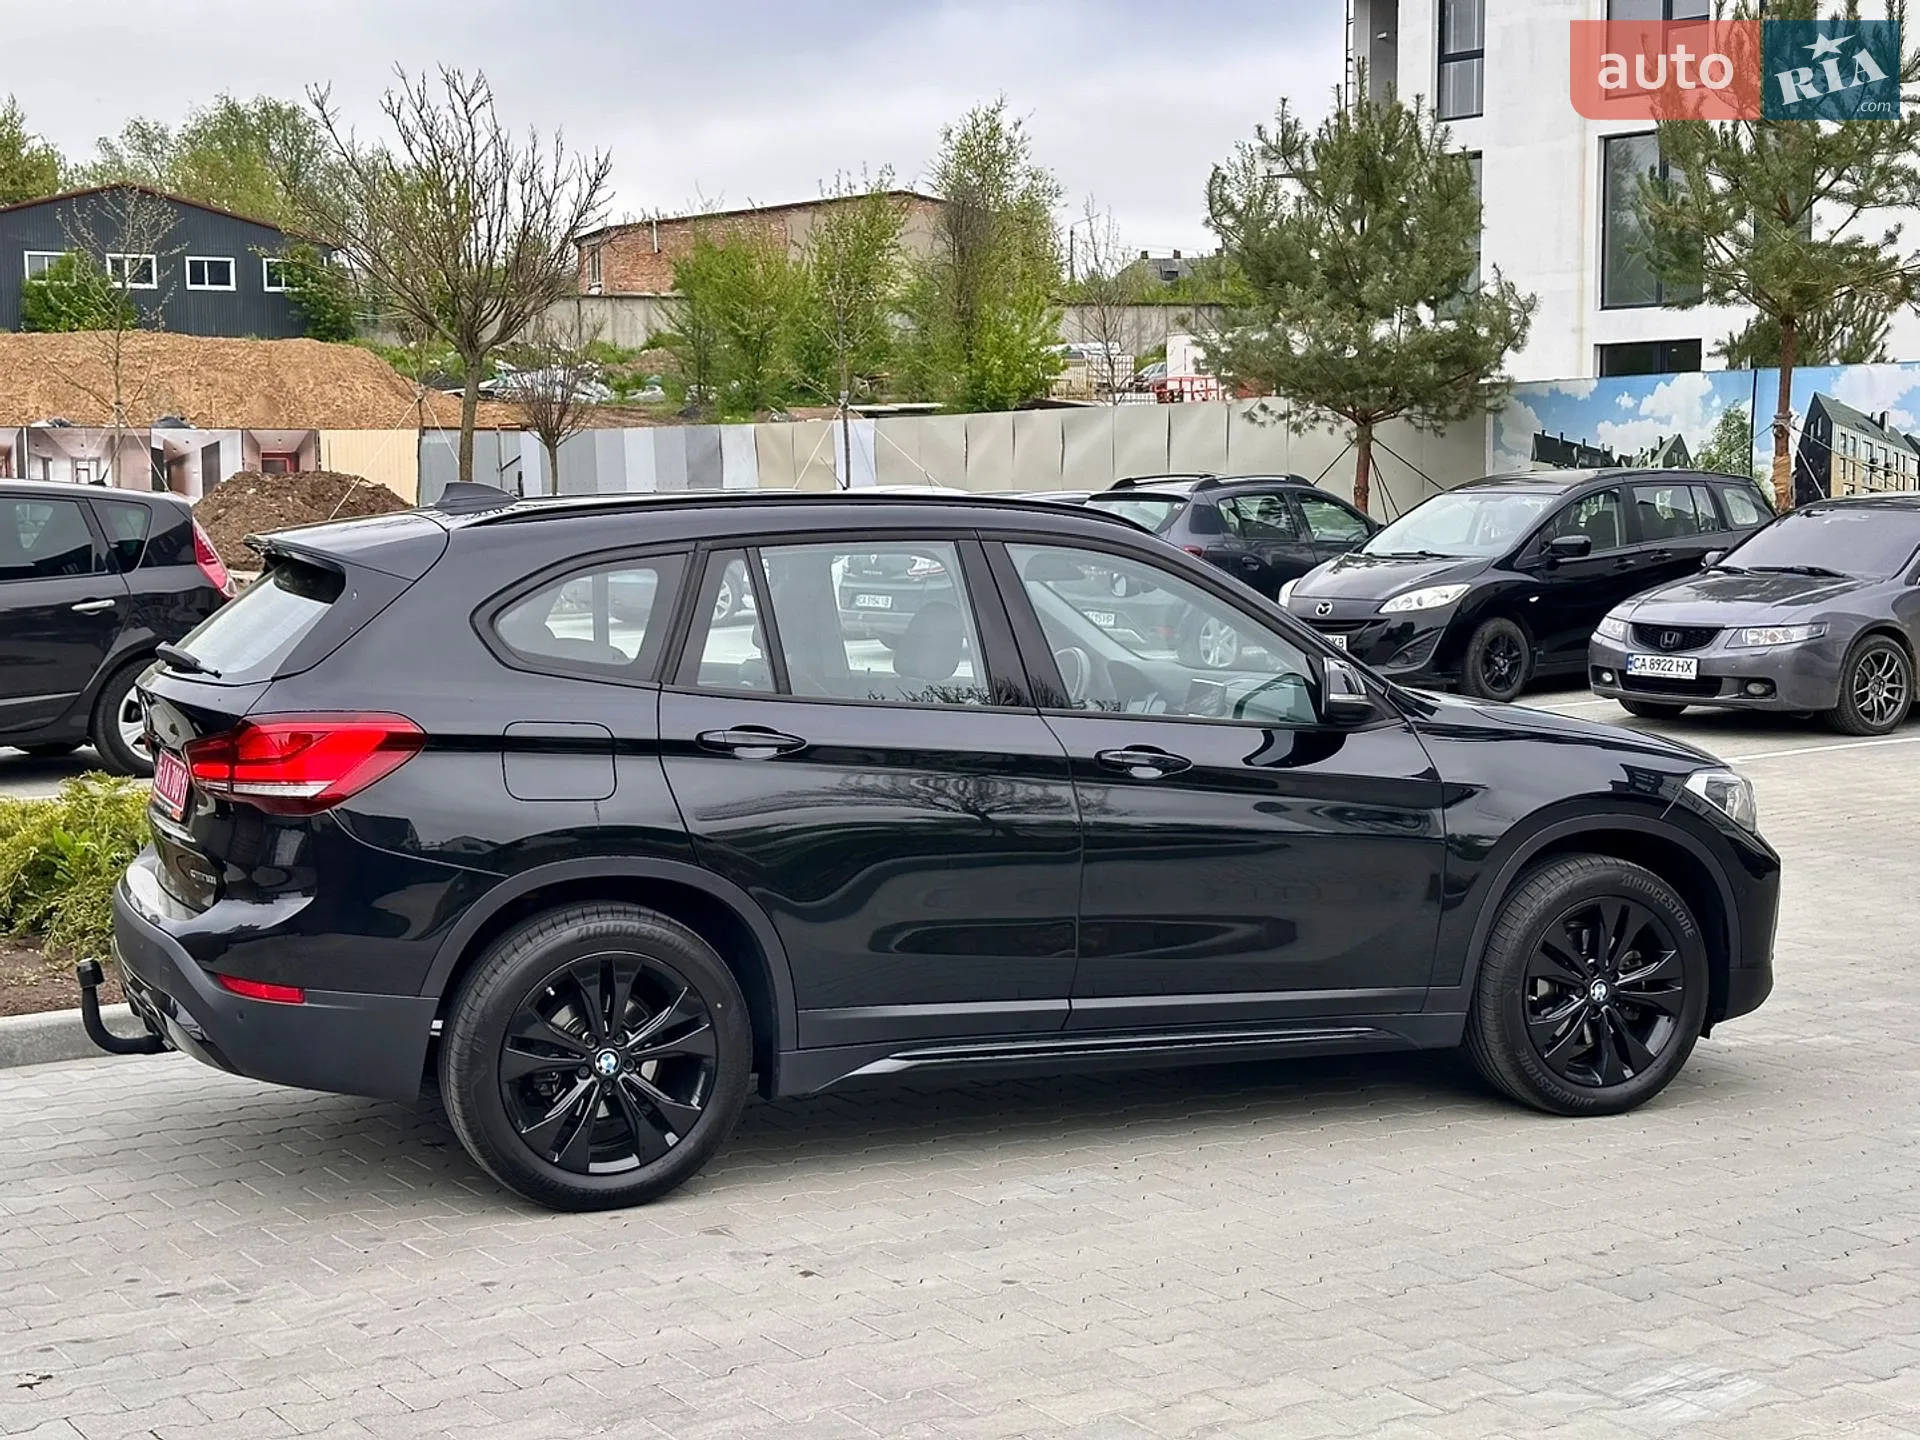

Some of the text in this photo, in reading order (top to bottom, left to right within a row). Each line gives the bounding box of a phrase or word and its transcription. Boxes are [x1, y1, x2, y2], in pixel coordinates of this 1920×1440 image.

[1633, 657, 1647, 671] CA
[1676, 660, 1693, 674] HX
[1620, 873, 1696, 939] BRIDGESTONE
